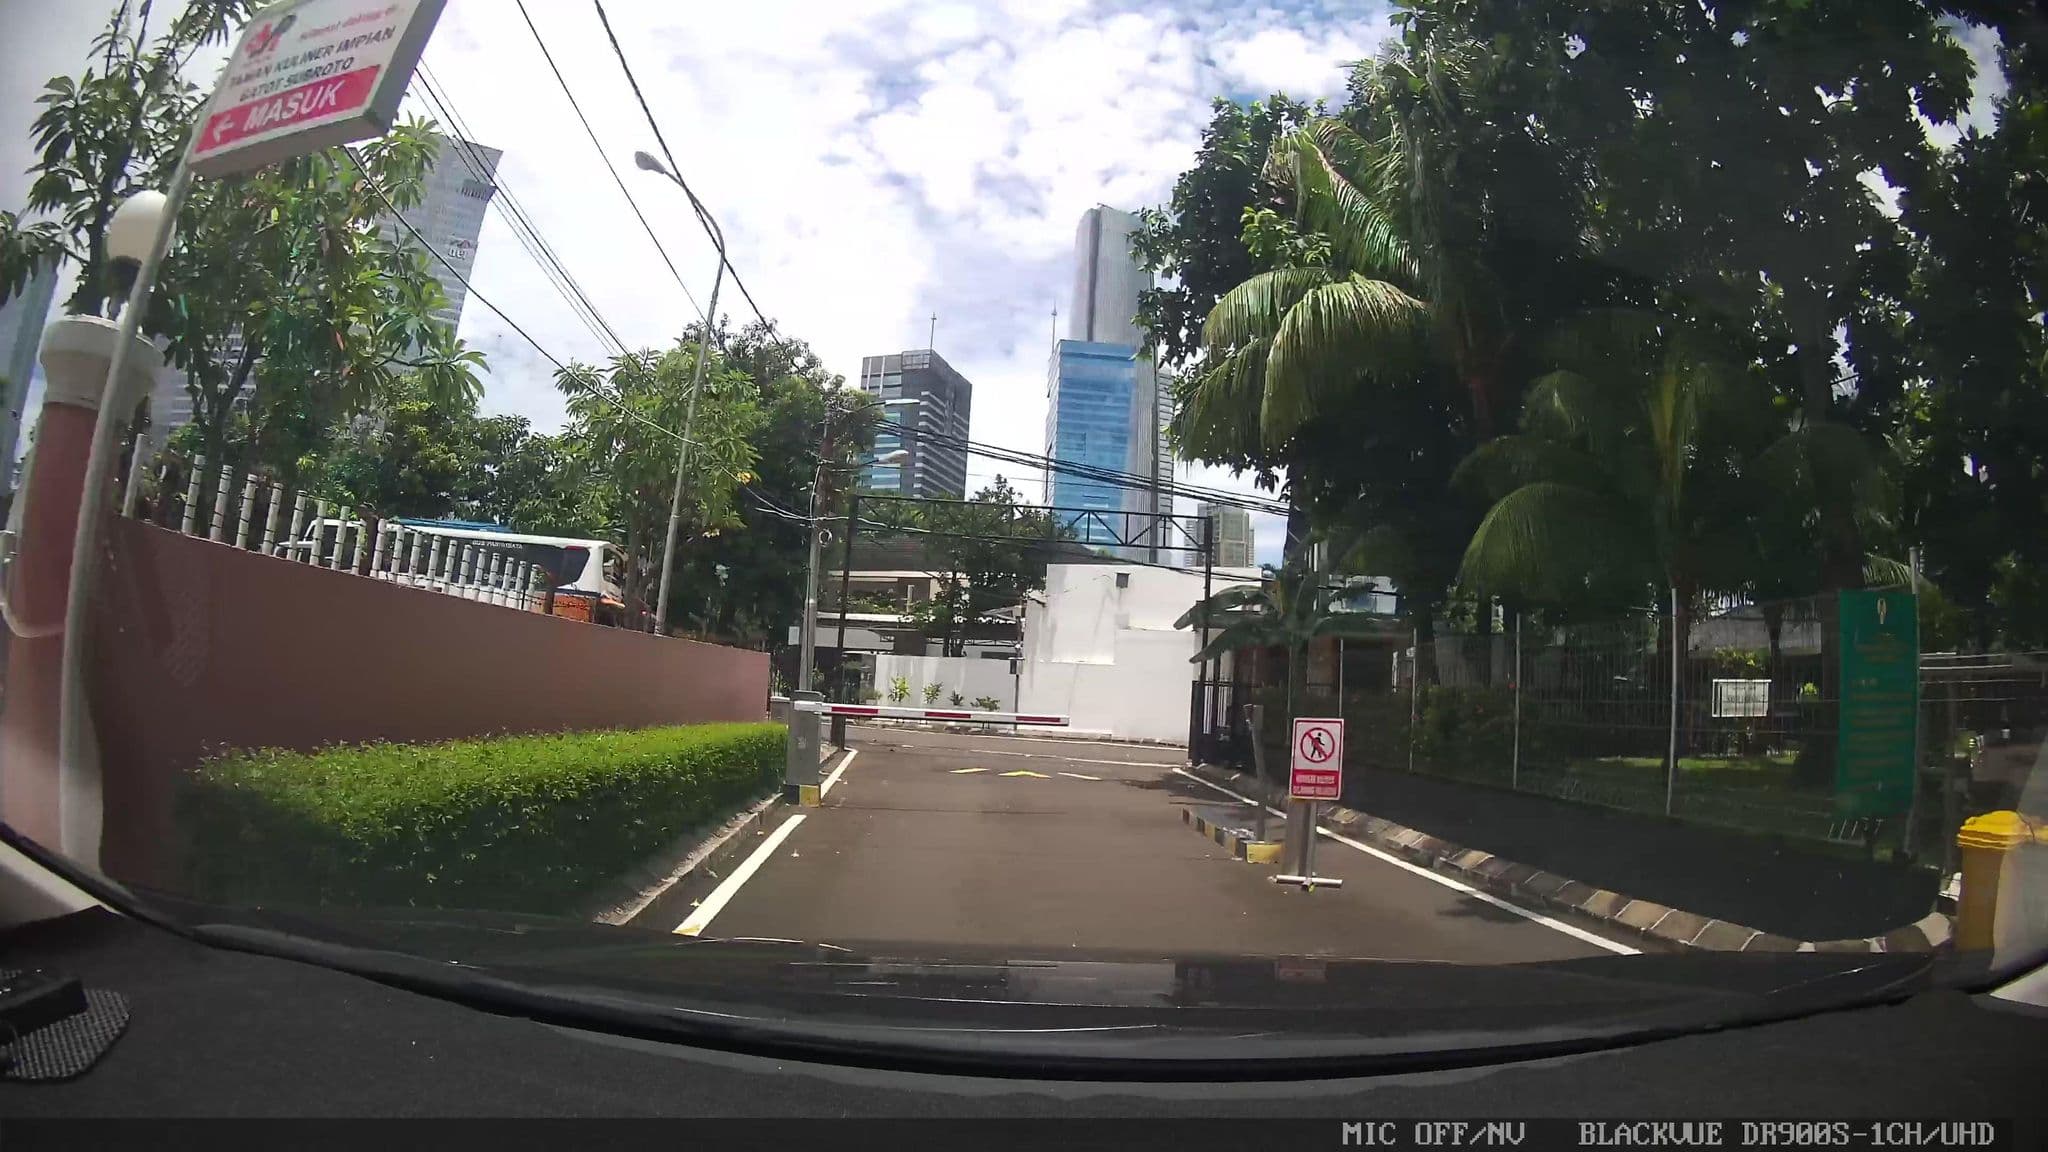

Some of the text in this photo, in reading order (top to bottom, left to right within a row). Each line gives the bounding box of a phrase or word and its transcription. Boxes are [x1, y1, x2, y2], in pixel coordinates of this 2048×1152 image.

[230, 66, 273, 88] TAMAN
[274, 44, 334, 73] KULINER
[335, 26, 397, 54] IMPIAN
[240, 78, 285, 102] GATOT
[285, 57, 355, 88] SUBROTO
[243, 80, 345, 131] MASUK
